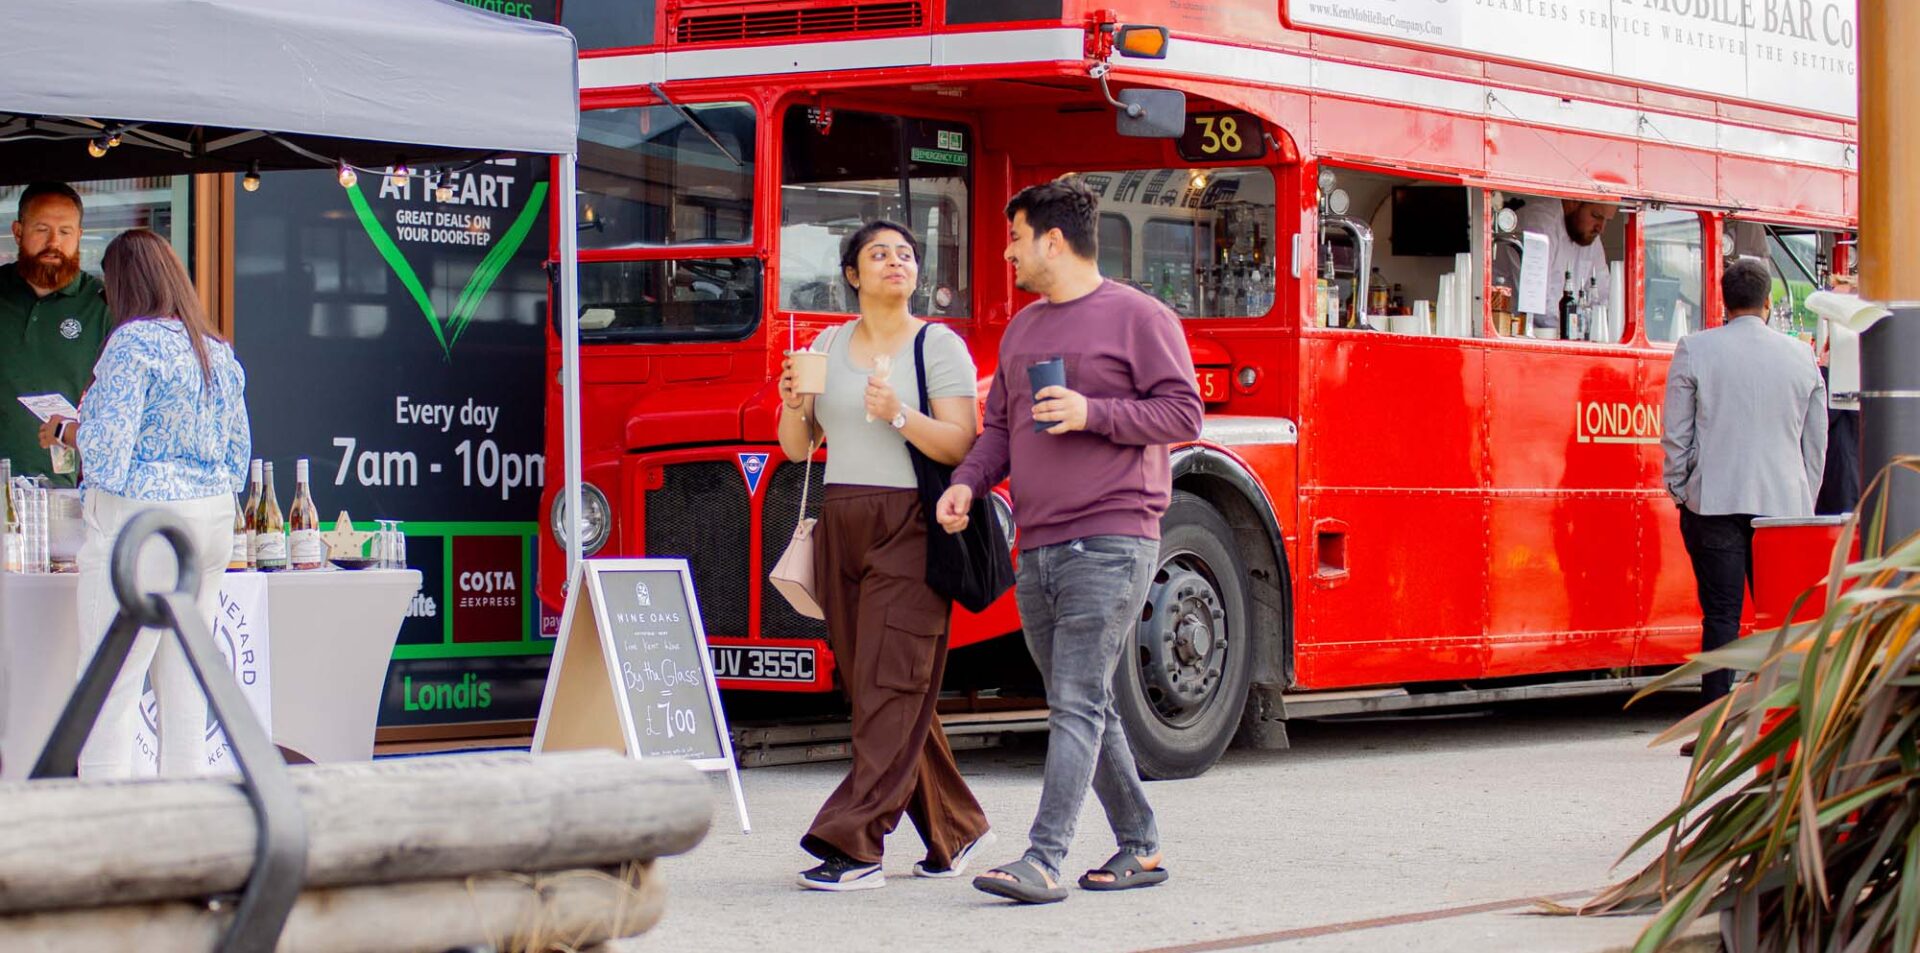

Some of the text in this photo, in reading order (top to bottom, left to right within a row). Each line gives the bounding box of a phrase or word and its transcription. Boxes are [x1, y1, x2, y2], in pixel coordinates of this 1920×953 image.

[1475, 0, 1855, 76] AMLESS SERVICE WHATEVER THE SETTING
[1643, 0, 1756, 29] BILE
[1762, 0, 1817, 42] BAR
[1195, 116, 1242, 154] 38
[918, 150, 952, 161] EMERGENCY
[378, 166, 515, 208] AT HEART
[396, 209, 491, 230] GREAT DEALS ON
[396, 227, 490, 246] YOUR DOORSTEP
[396, 396, 499, 434] Every day
[1576, 401, 1660, 444] LONDON
[332, 437, 545, 501] 7am - 10pm
[459, 571, 516, 593] COSTA
[467, 596, 516, 608] EXPRESS
[650, 612, 680, 623] OAKS
[623, 658, 700, 693] By the Glass
[748, 650, 813, 678] 355C
[403, 672, 492, 712] Londis
